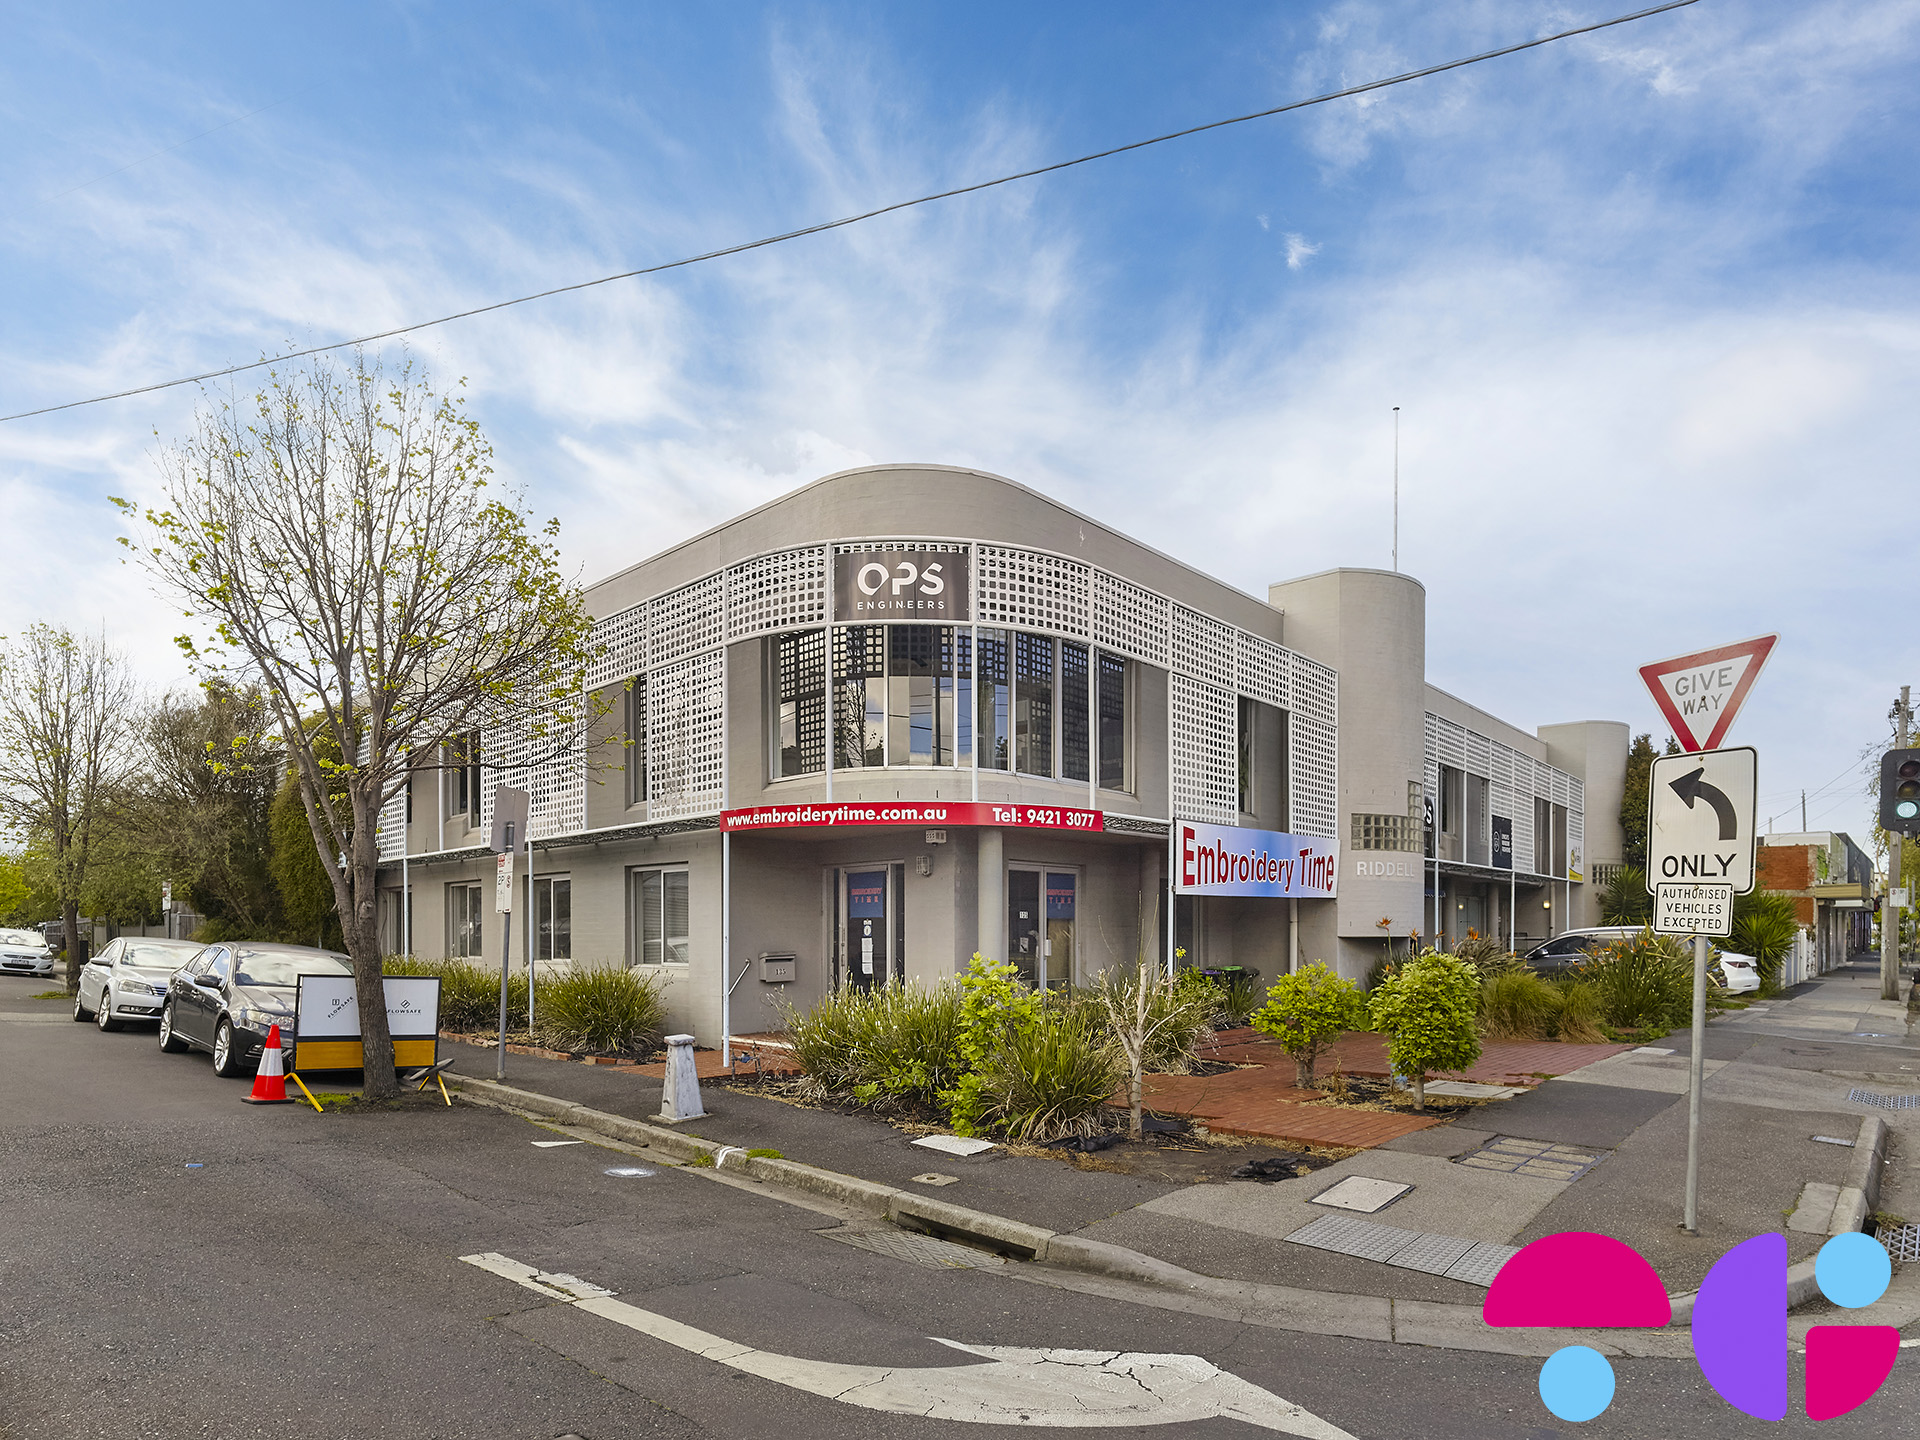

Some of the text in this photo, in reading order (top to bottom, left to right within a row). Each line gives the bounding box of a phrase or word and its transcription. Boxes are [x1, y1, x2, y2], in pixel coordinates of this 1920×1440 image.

[857, 561, 945, 596] OPS
[857, 600, 945, 611] ENGINEERS
[1675, 666, 1733, 697] GIVE
[1682, 692, 1724, 716] WAY
[726, 805, 947, 827] www.embroiderytime.com.au
[992, 807, 1096, 828] Tel: 9421 3077
[1182, 825, 1335, 894] Embroidery Time
[1356, 861, 1415, 877] RIDDELL
[1661, 853, 1738, 878] ONLY
[1661, 888, 1728, 900] AUTHORISED
[1666, 902, 1722, 915] VEHICLES
[1663, 916, 1722, 930] EXCEPTED
[327, 996, 354, 1019] FLOWSAFE
